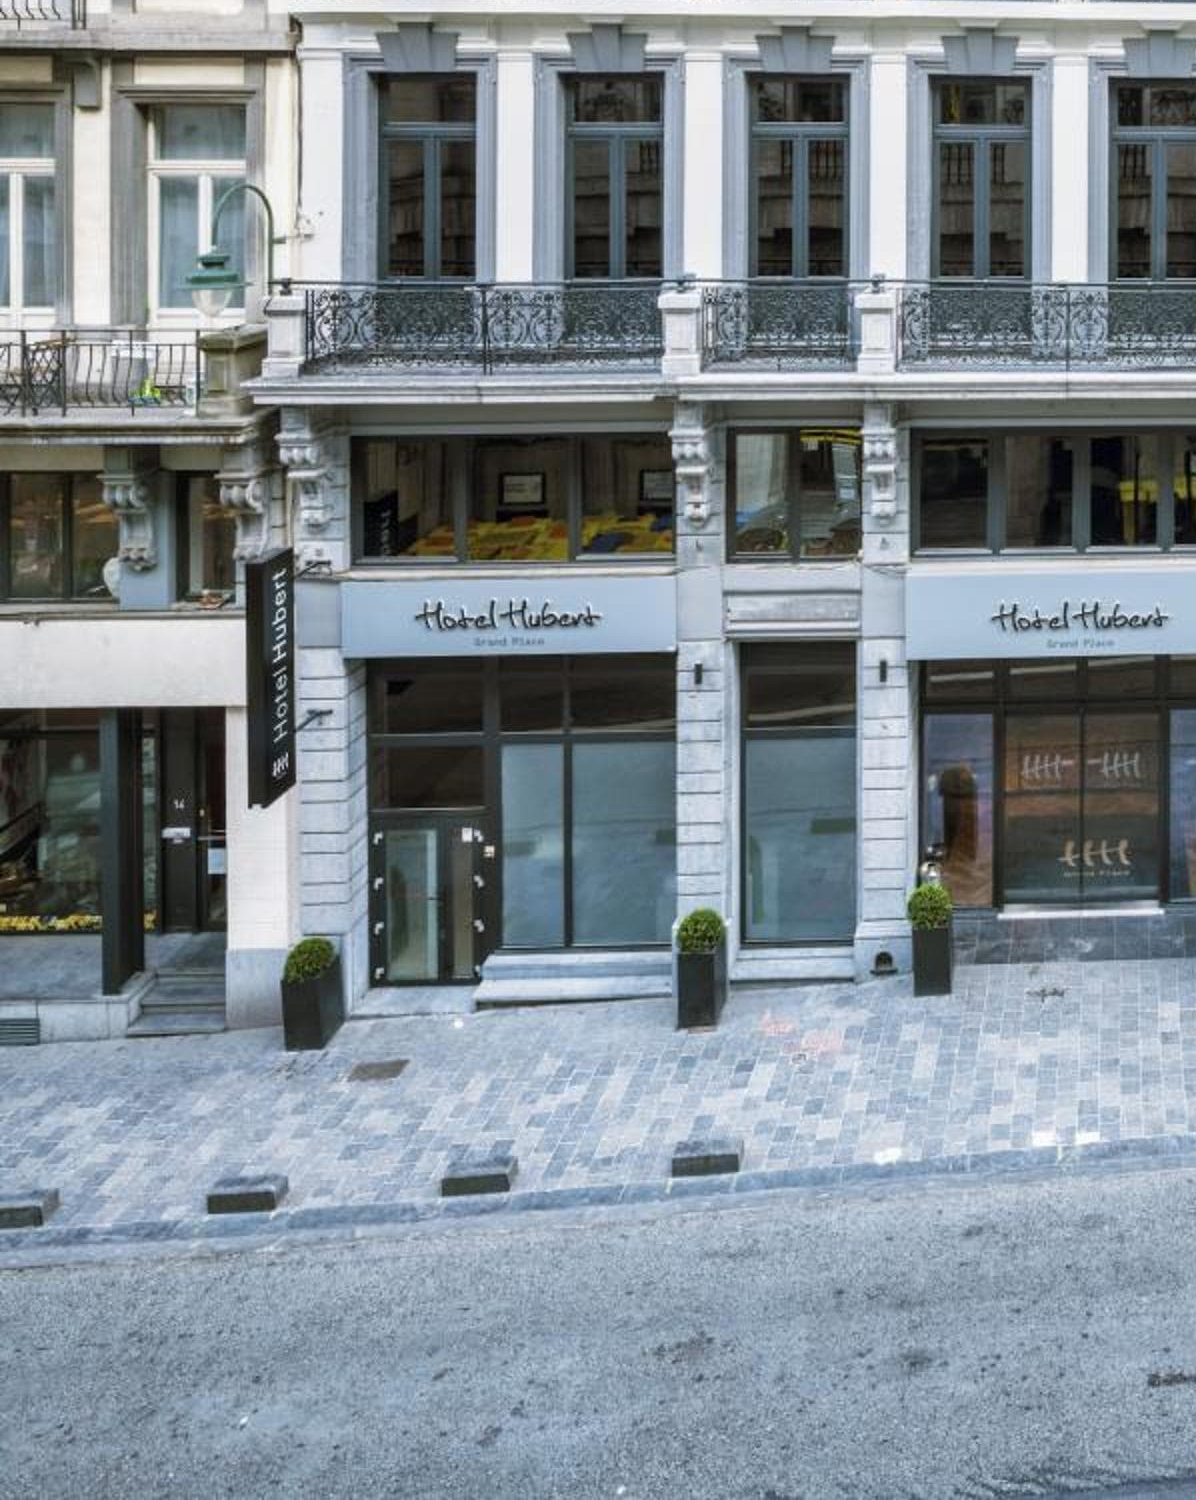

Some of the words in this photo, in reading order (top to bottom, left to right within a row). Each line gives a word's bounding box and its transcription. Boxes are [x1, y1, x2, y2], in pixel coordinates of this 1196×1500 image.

[271, 567, 287, 663] Hubert
[415, 598, 497, 631] Hotel
[500, 598, 604, 630] Hubert
[991, 600, 1070, 632] Hotel
[1072, 600, 1169, 631] Hubert
[272, 665, 288, 743] Hotel
